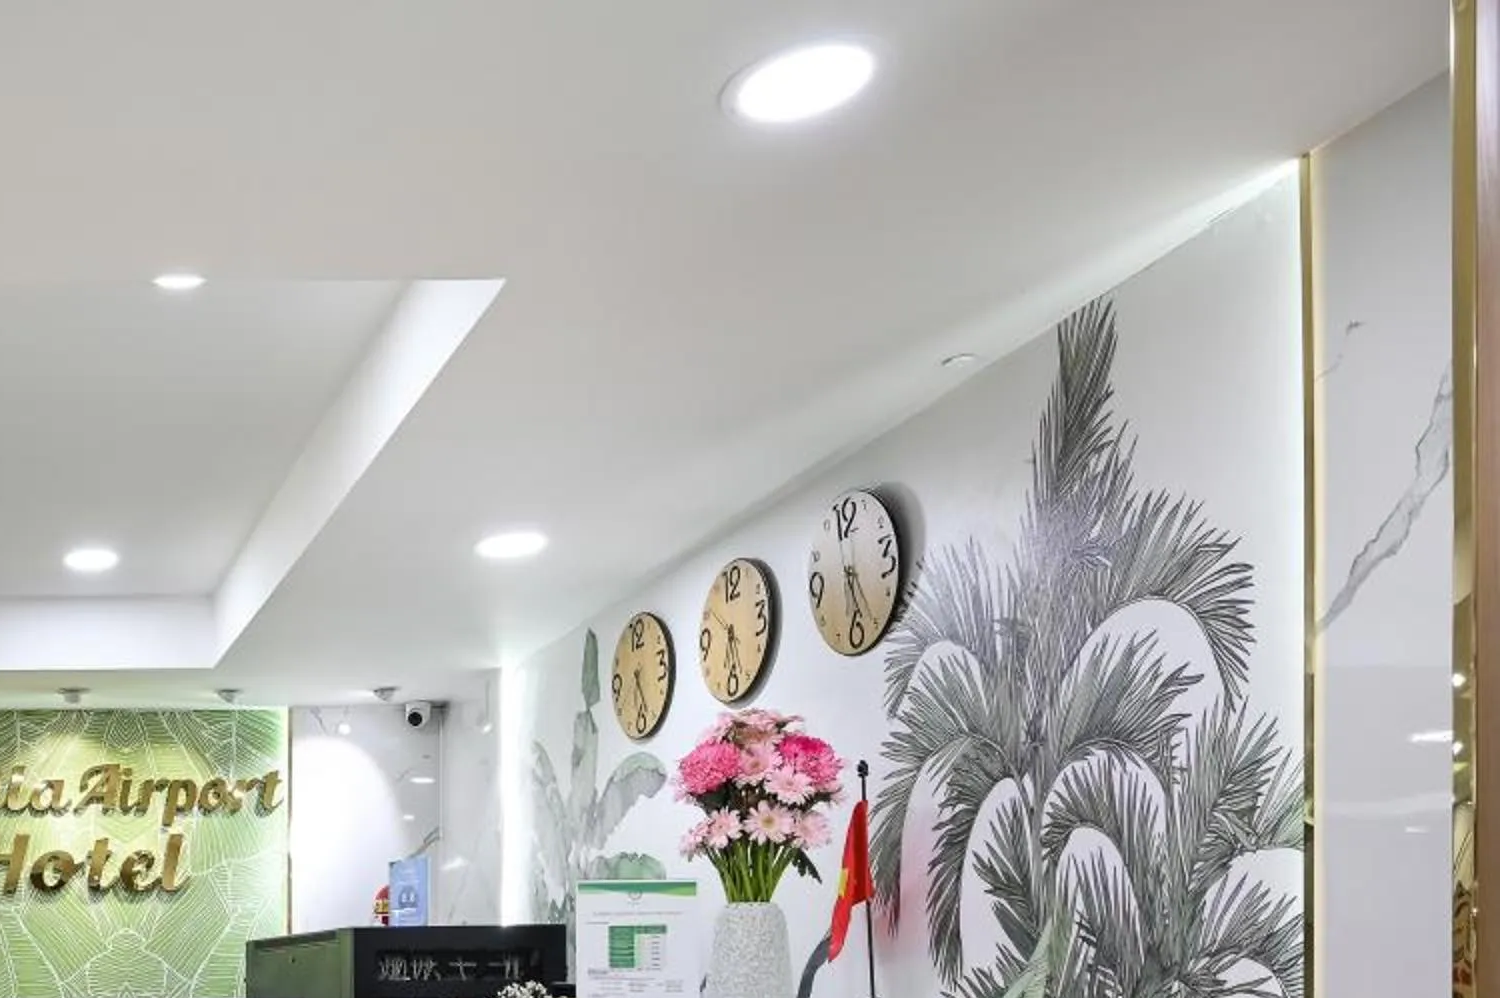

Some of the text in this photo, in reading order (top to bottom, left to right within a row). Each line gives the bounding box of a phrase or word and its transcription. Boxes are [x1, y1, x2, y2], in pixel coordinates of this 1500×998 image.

[833, 497, 859, 541] 12
[878, 534, 897, 579] 3
[722, 565, 741, 604] 12
[809, 571, 824, 609] 9
[631, 618, 645, 652] 12
[755, 599, 767, 637] 3
[849, 609, 864, 649] 6
[700, 627, 711, 661] 9
[611, 673, 623, 703] 9
[73, 763, 285, 827] Airport
